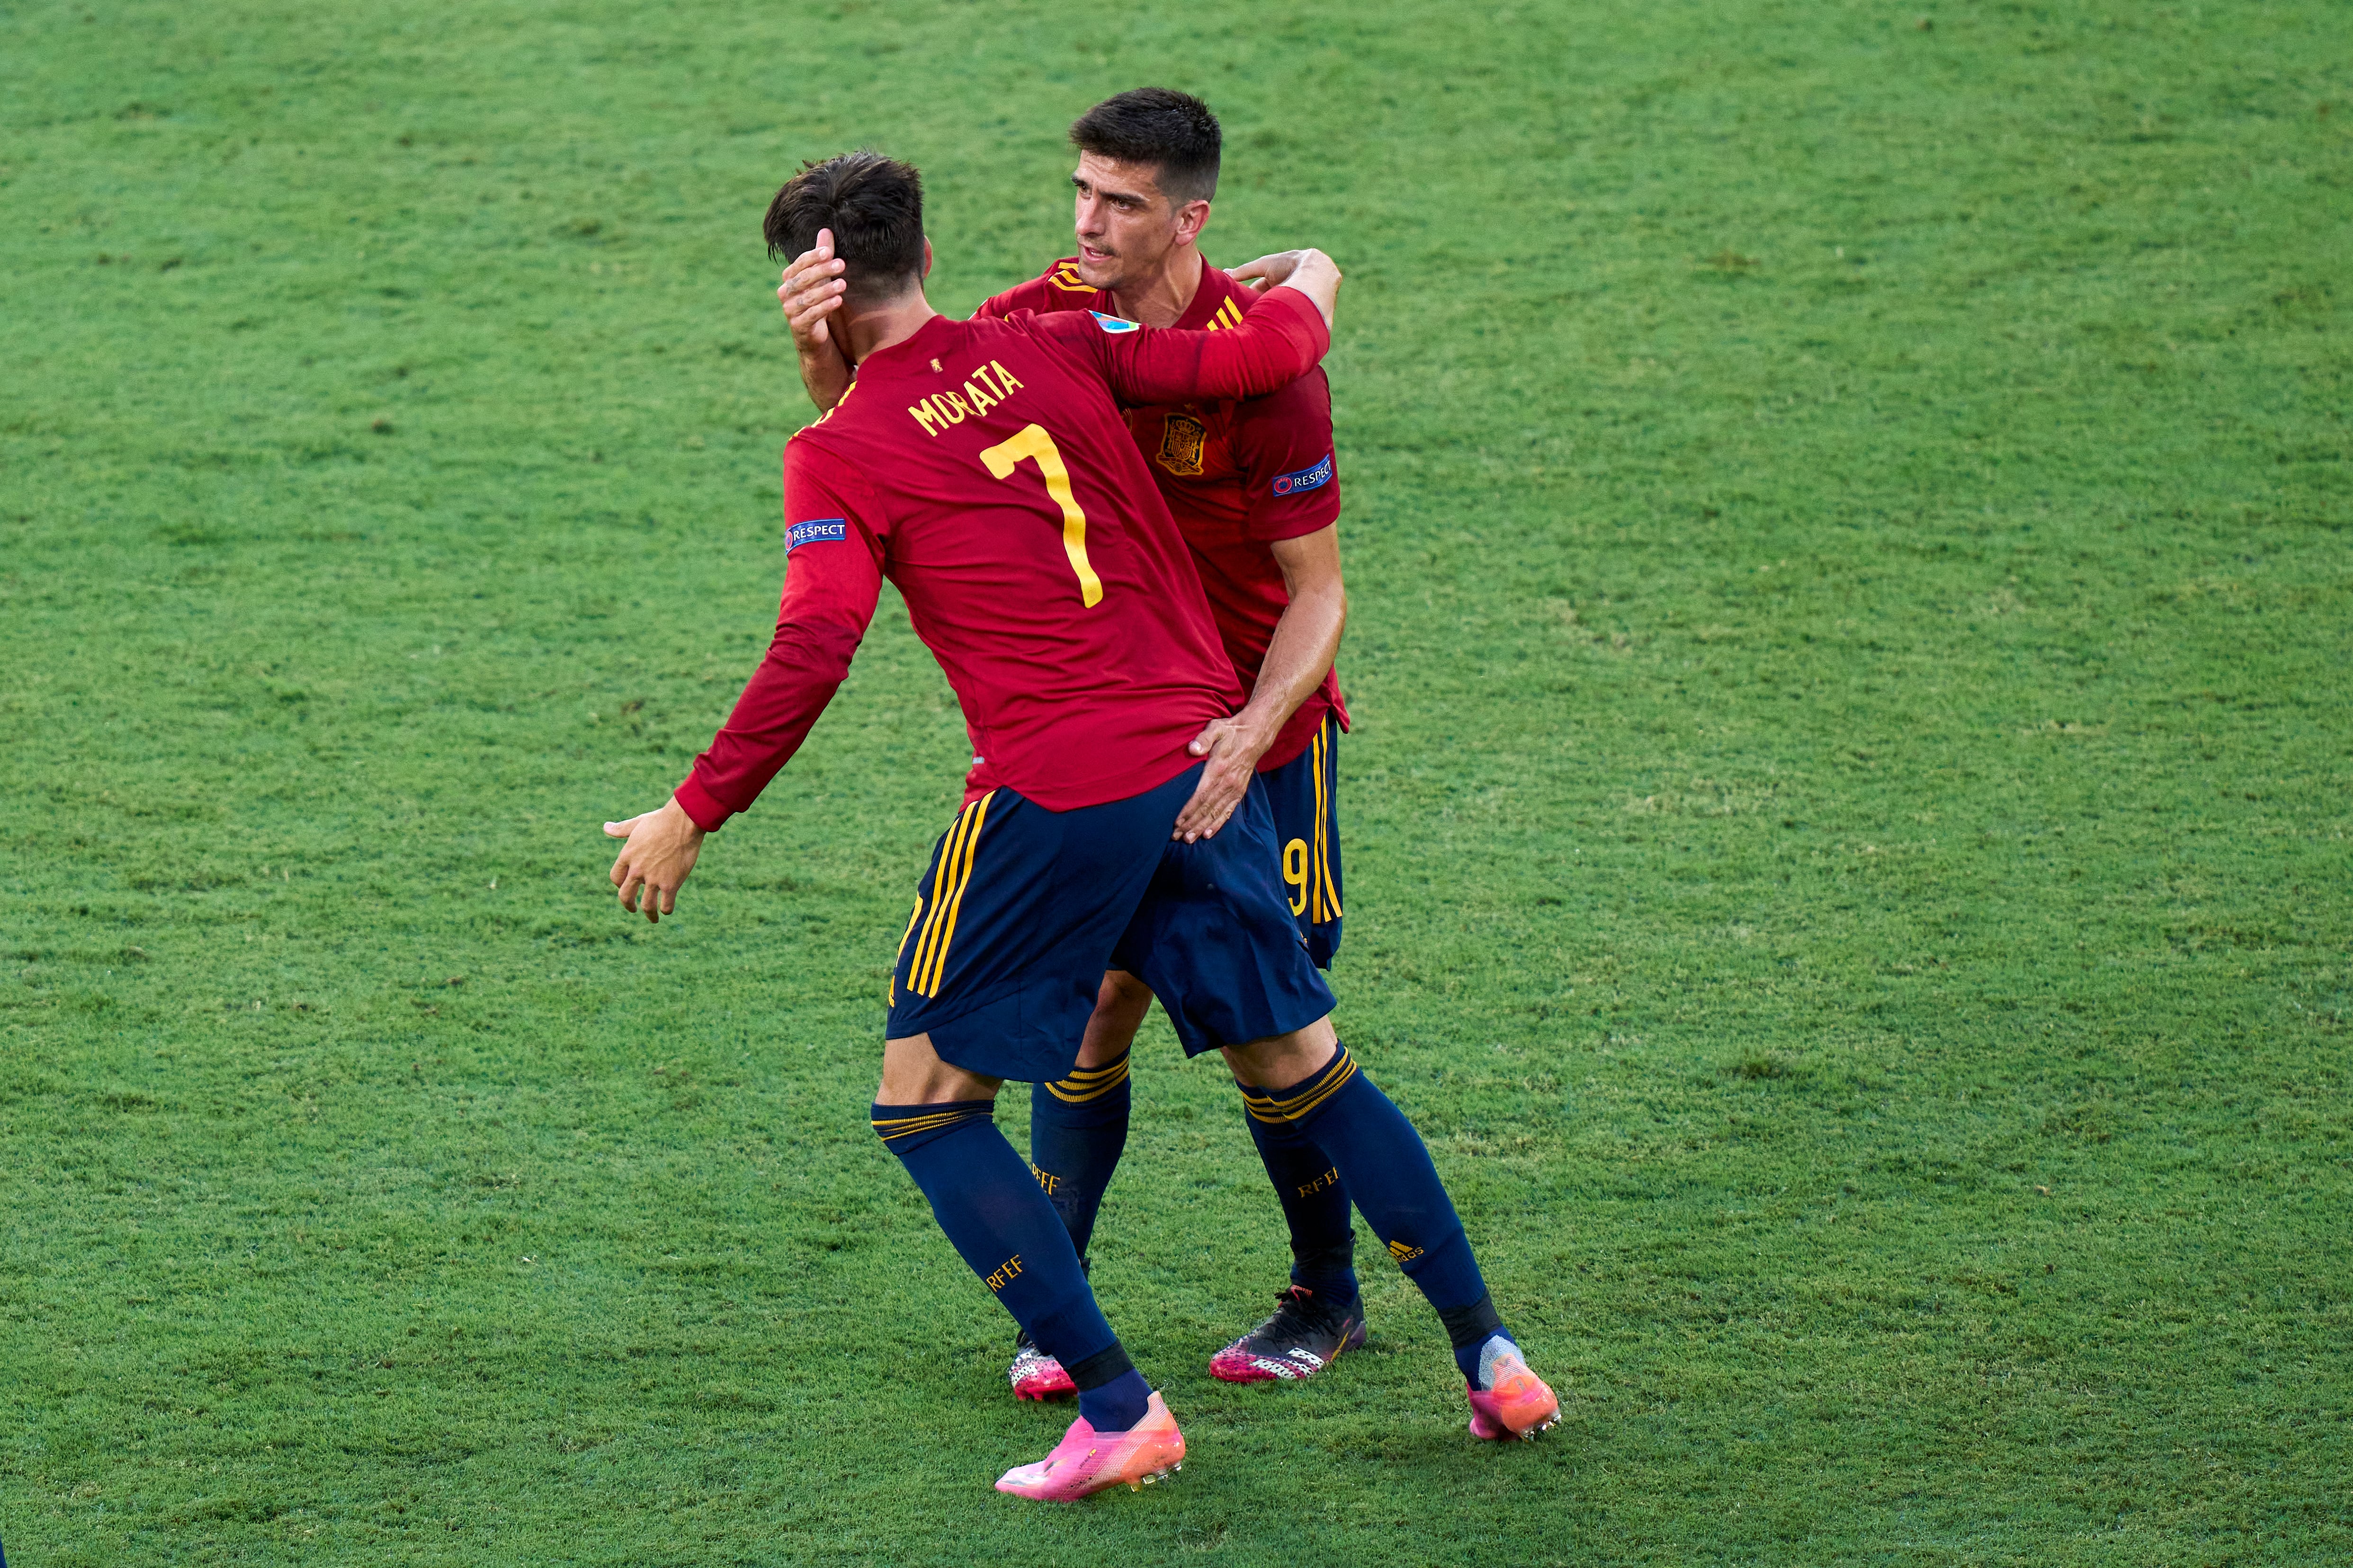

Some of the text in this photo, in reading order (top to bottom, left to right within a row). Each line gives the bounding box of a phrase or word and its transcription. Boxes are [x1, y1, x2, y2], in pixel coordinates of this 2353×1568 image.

[908, 360, 1024, 437] MORATA
[1294, 460, 1331, 487] RESPECT
[793, 525, 845, 541] RESPECT
[979, 423, 1103, 609] 7
[1283, 838, 1308, 917] 9
[986, 1254, 1022, 1292] RFEF
